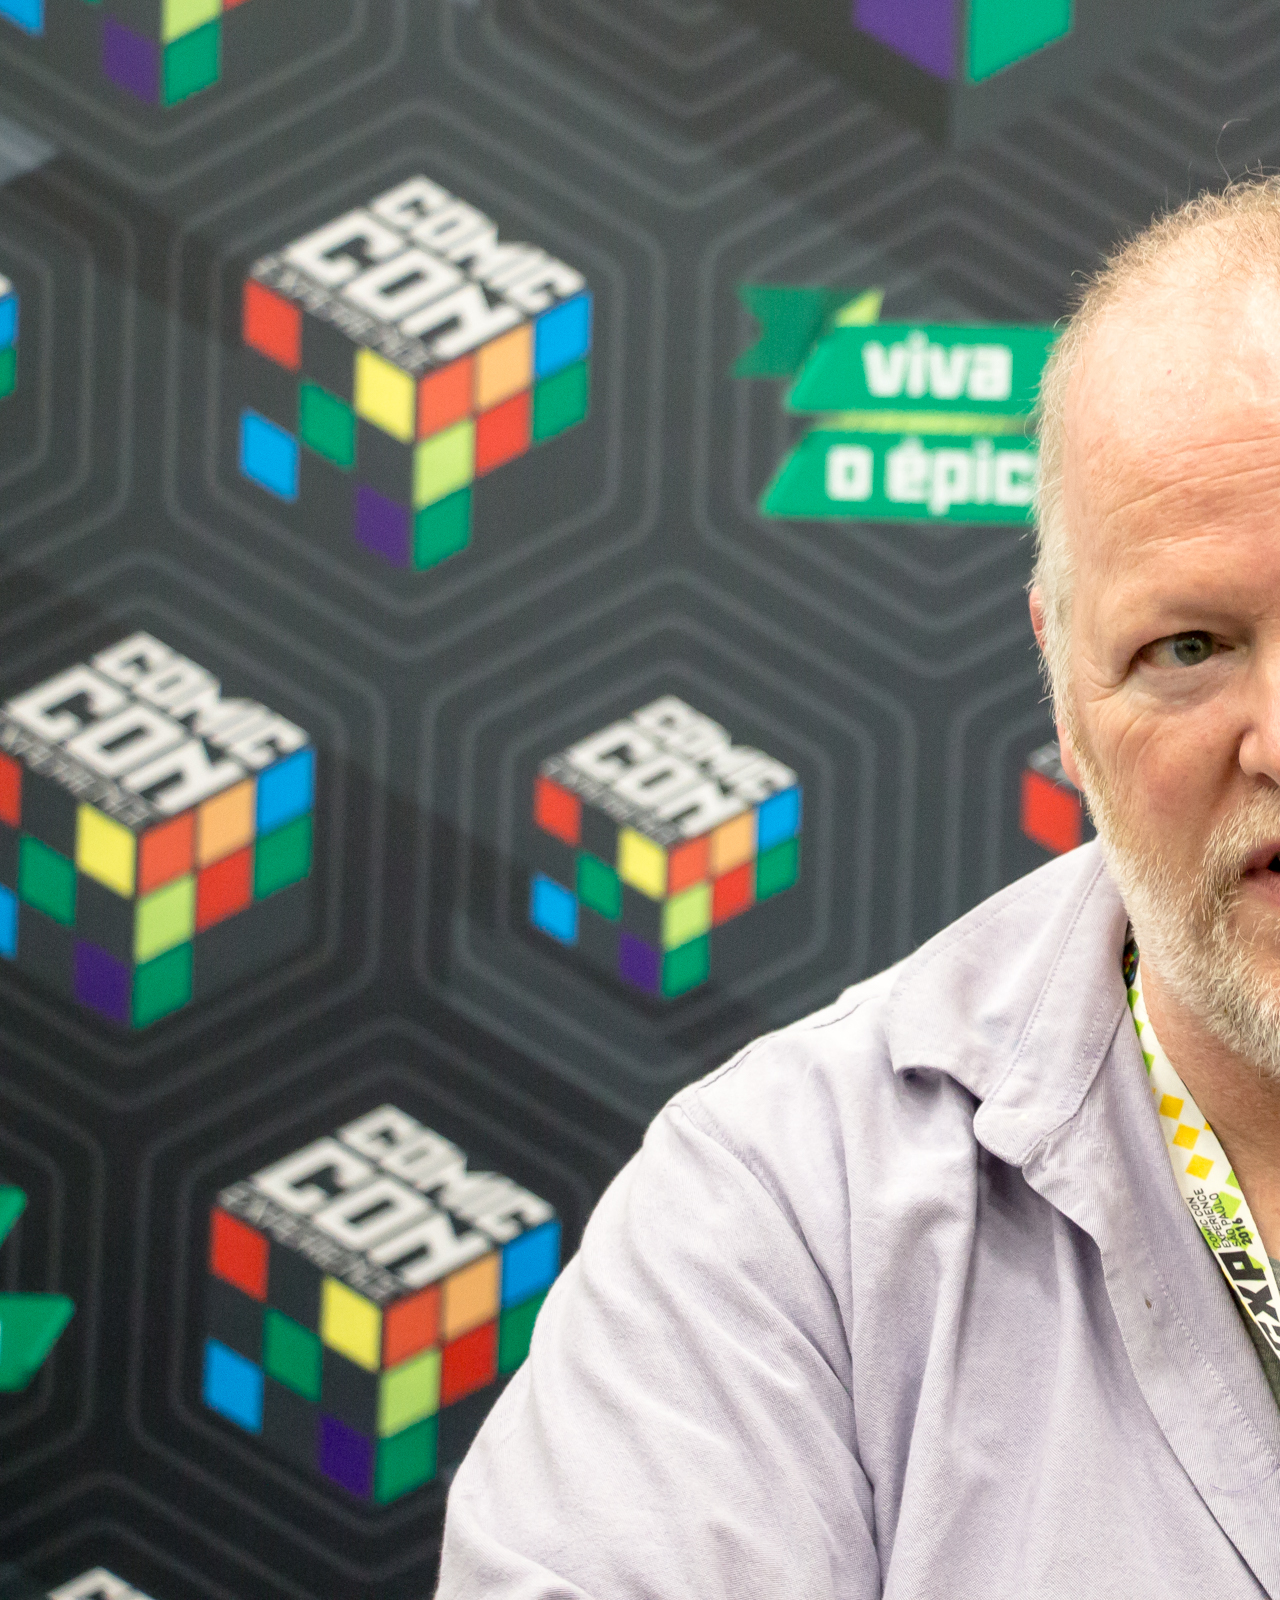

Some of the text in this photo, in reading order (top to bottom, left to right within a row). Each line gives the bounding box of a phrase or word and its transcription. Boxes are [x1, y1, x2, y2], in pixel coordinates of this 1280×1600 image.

[282, 206, 524, 359] CON
[368, 174, 586, 315] COMIC
[861, 329, 1013, 401] viva
[825, 434, 1040, 517] o épic
[5, 662, 248, 816] CON
[91, 630, 311, 771] COMIC
[633, 694, 798, 803] COMIC
[567, 717, 752, 840] CON
[252, 1136, 493, 1289] CON
[337, 1102, 556, 1245] COMIC
[1186, 1196, 1222, 1249] COMIC CON
[1193, 1188, 1231, 1248] EXPERIENCE
[1209, 1192, 1231, 1226] PAULO
[1232, 1217, 1253, 1246] 2016
